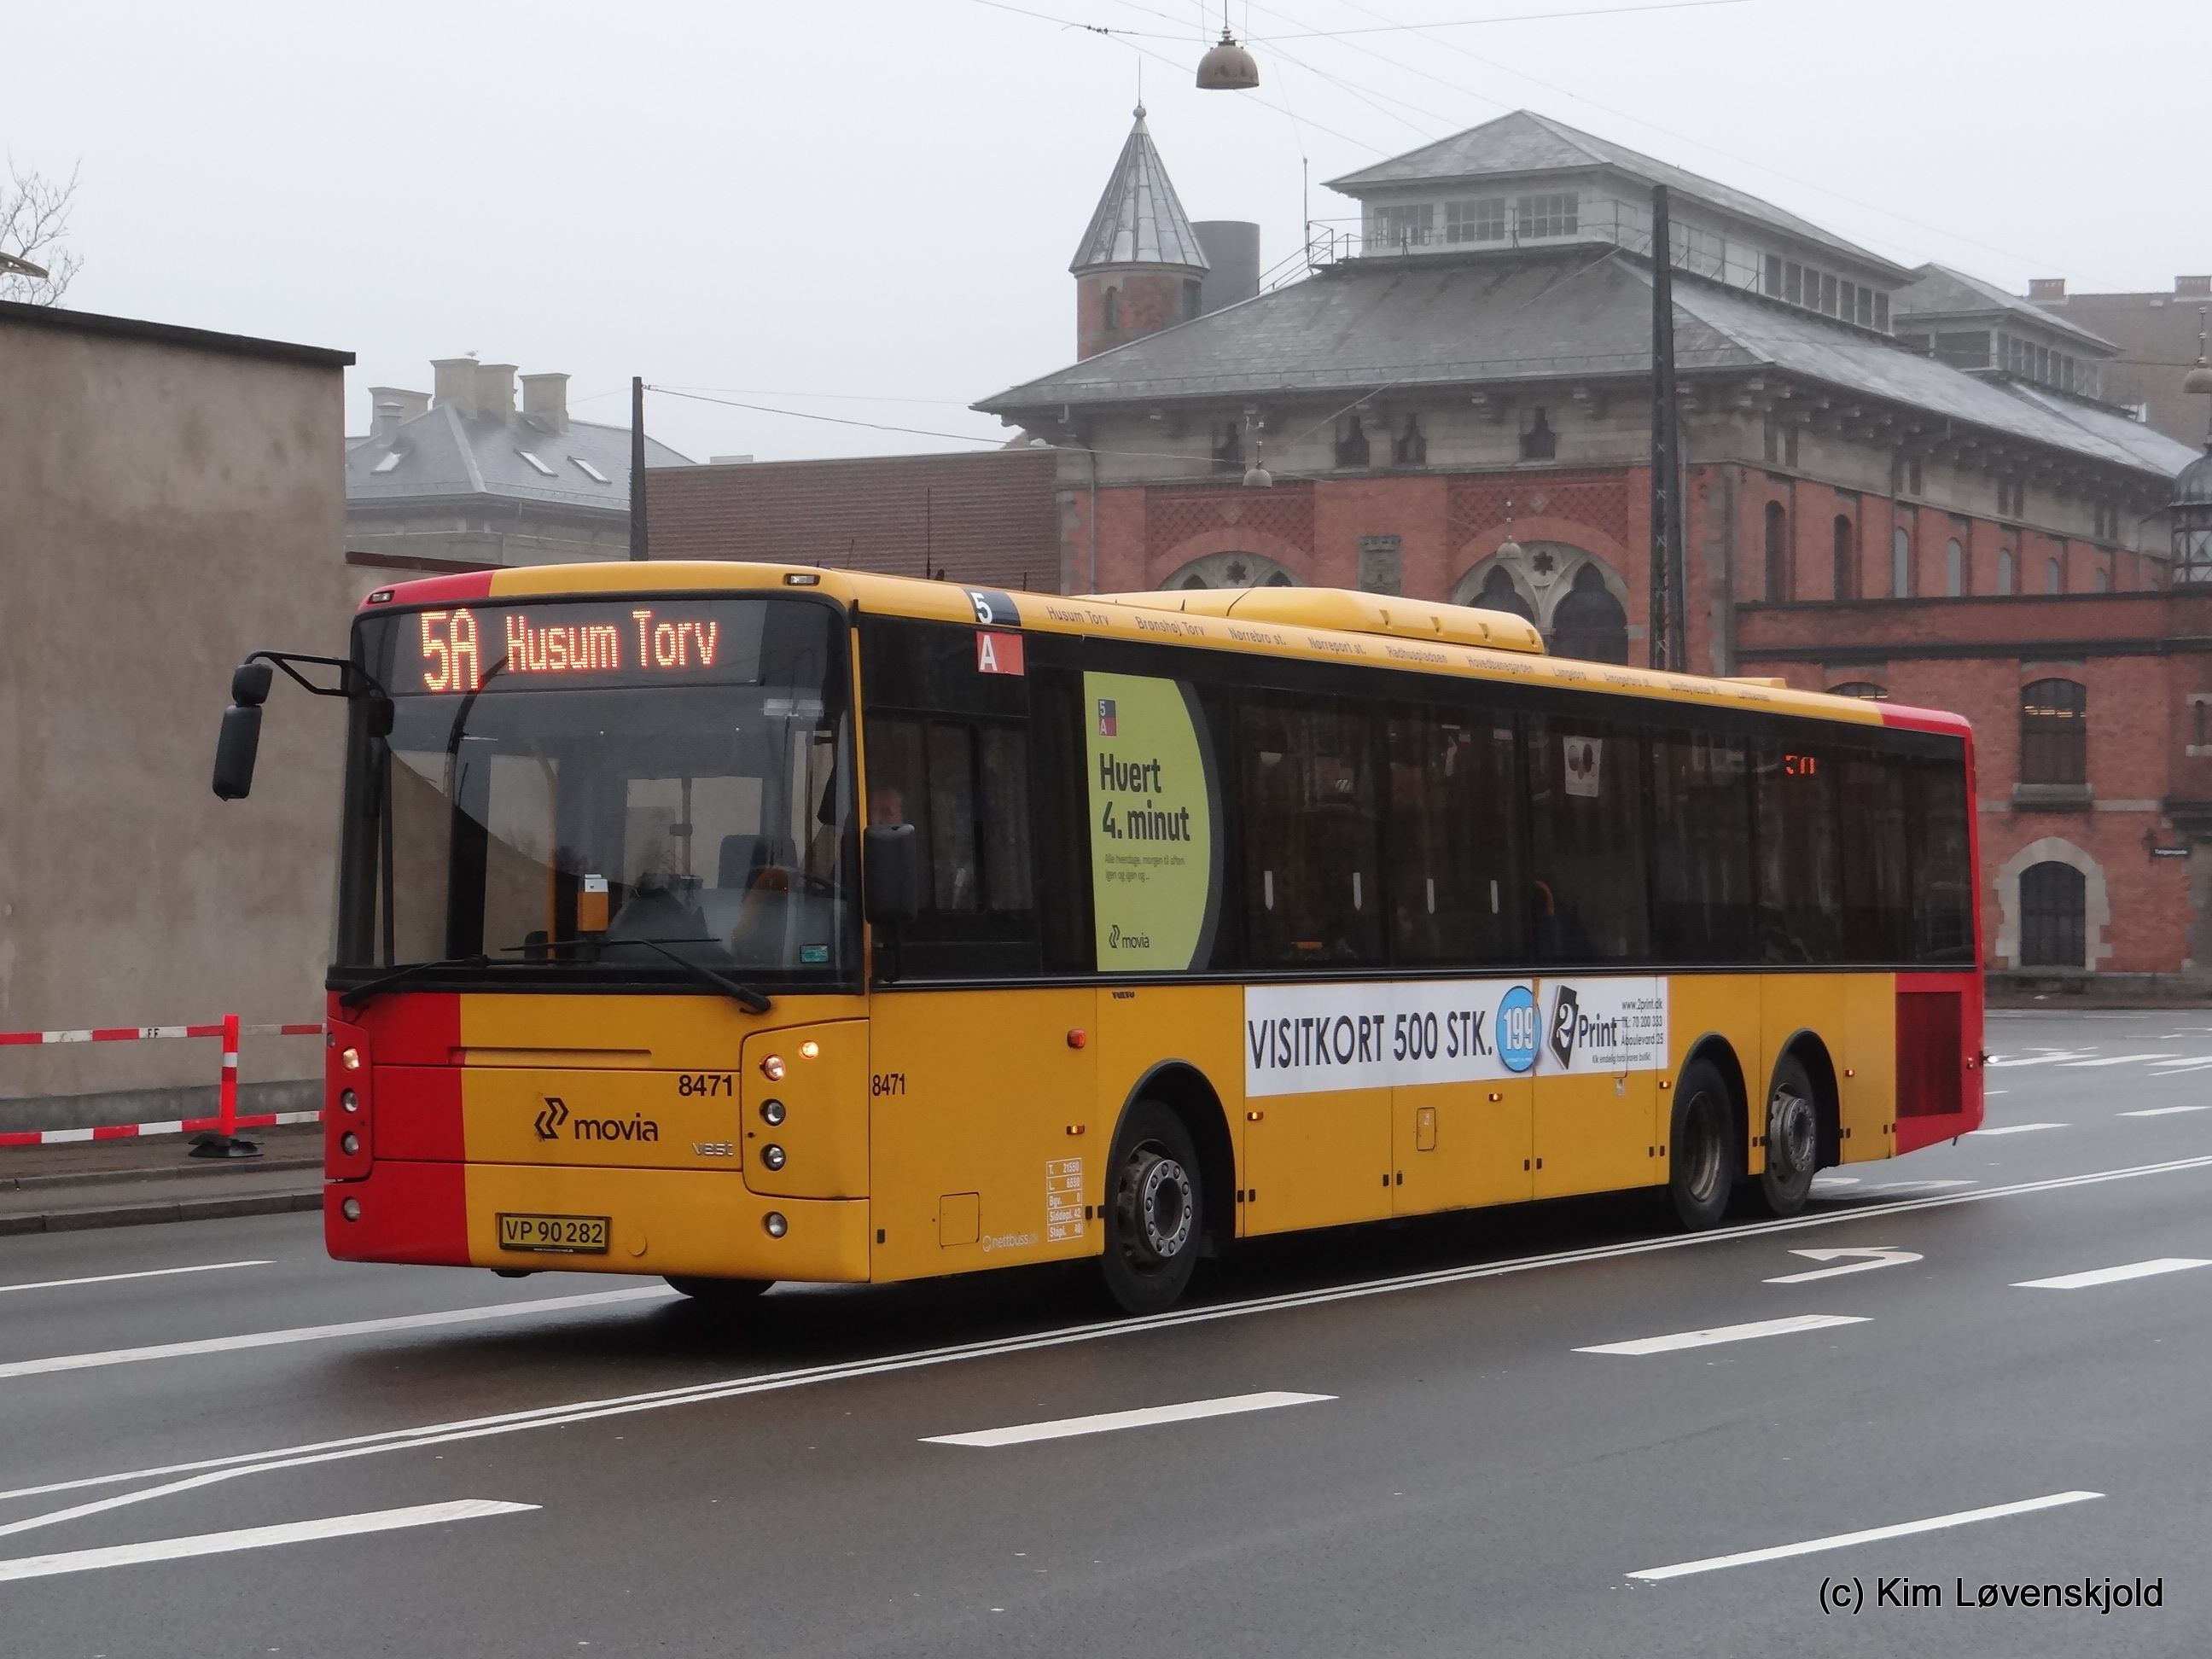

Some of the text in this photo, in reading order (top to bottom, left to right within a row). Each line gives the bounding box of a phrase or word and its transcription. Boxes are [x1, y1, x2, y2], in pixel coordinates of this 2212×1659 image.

[970, 592, 992, 624] 5
[1045, 605, 1109, 626] Husum Torv
[1134, 615, 1205, 637] Brønshøj Torv
[1228, 626, 1272, 645] Nørrebro
[420, 608, 717, 691] 5A Husum Torv
[979, 634, 998, 672] A
[1099, 700, 1106, 717] 5
[1100, 719, 1108, 735] A
[1099, 753, 1161, 794] Hvert
[1102, 799, 1190, 841] 4. minut
[1121, 932, 1150, 949] movia
[1248, 1010, 1493, 1069] VISITKORT 500 STK.
[1503, 1006, 1534, 1051] 199
[678, 1074, 734, 1097] 8471
[871, 1073, 905, 1097] 8471
[573, 1113, 659, 1142] movia
[506, 1220, 603, 1243] VP 90 282
